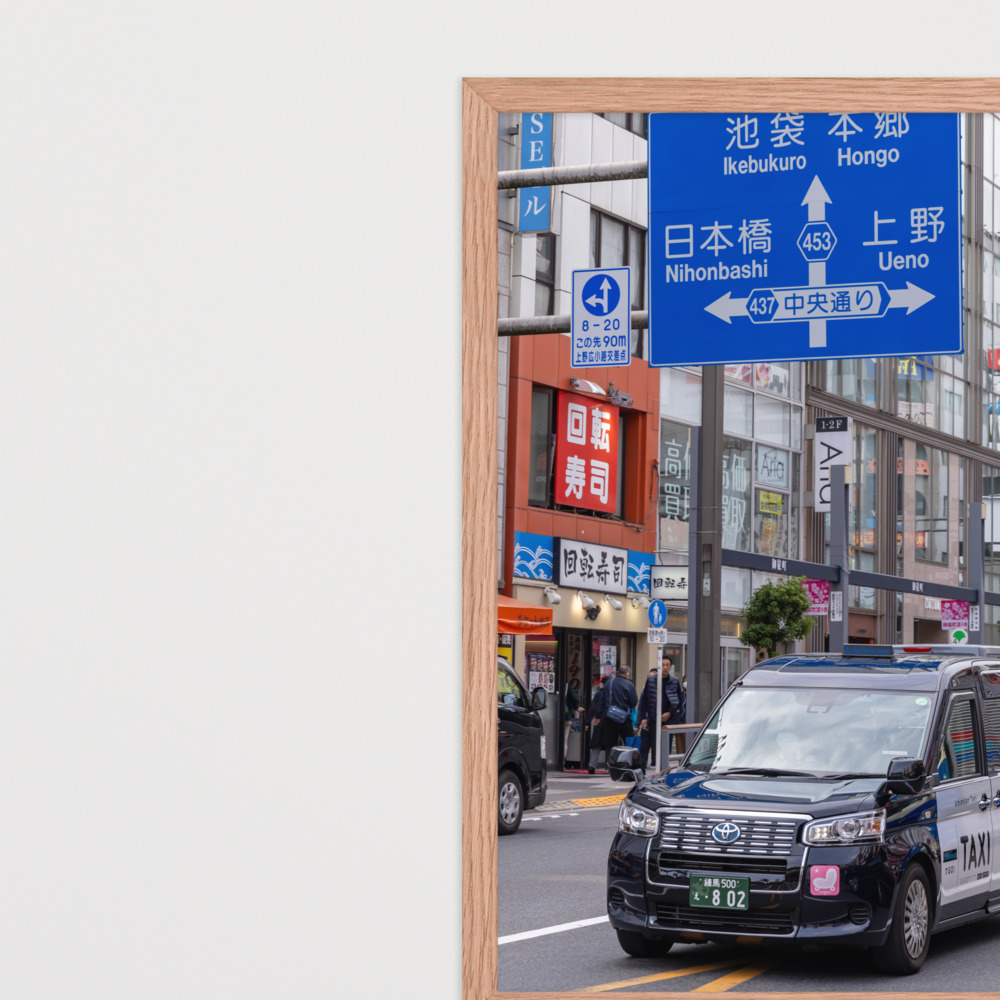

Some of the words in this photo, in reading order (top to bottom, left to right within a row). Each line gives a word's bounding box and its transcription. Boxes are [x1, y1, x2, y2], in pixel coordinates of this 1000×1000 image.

[725, 113, 805, 150] 池袋
[828, 113, 910, 143] 本郷
[723, 153, 807, 175] Ikebukuro
[837, 147, 900, 168] Hongo
[665, 218, 773, 259] 日本橋
[862, 206, 945, 246] 上野
[802, 231, 832, 251] 453
[665, 259, 768, 283] Nihonbashi
[878, 252, 930, 271] Ueno
[749, 297, 776, 315] 437
[784, 289, 874, 315] 中央通り
[566, 402, 611, 453] 回転
[564, 455, 610, 504] 寿司
[563, 548, 625, 587] 回転寿司
[960, 830, 991, 872] TAXI
[721, 879, 737, 889] 500
